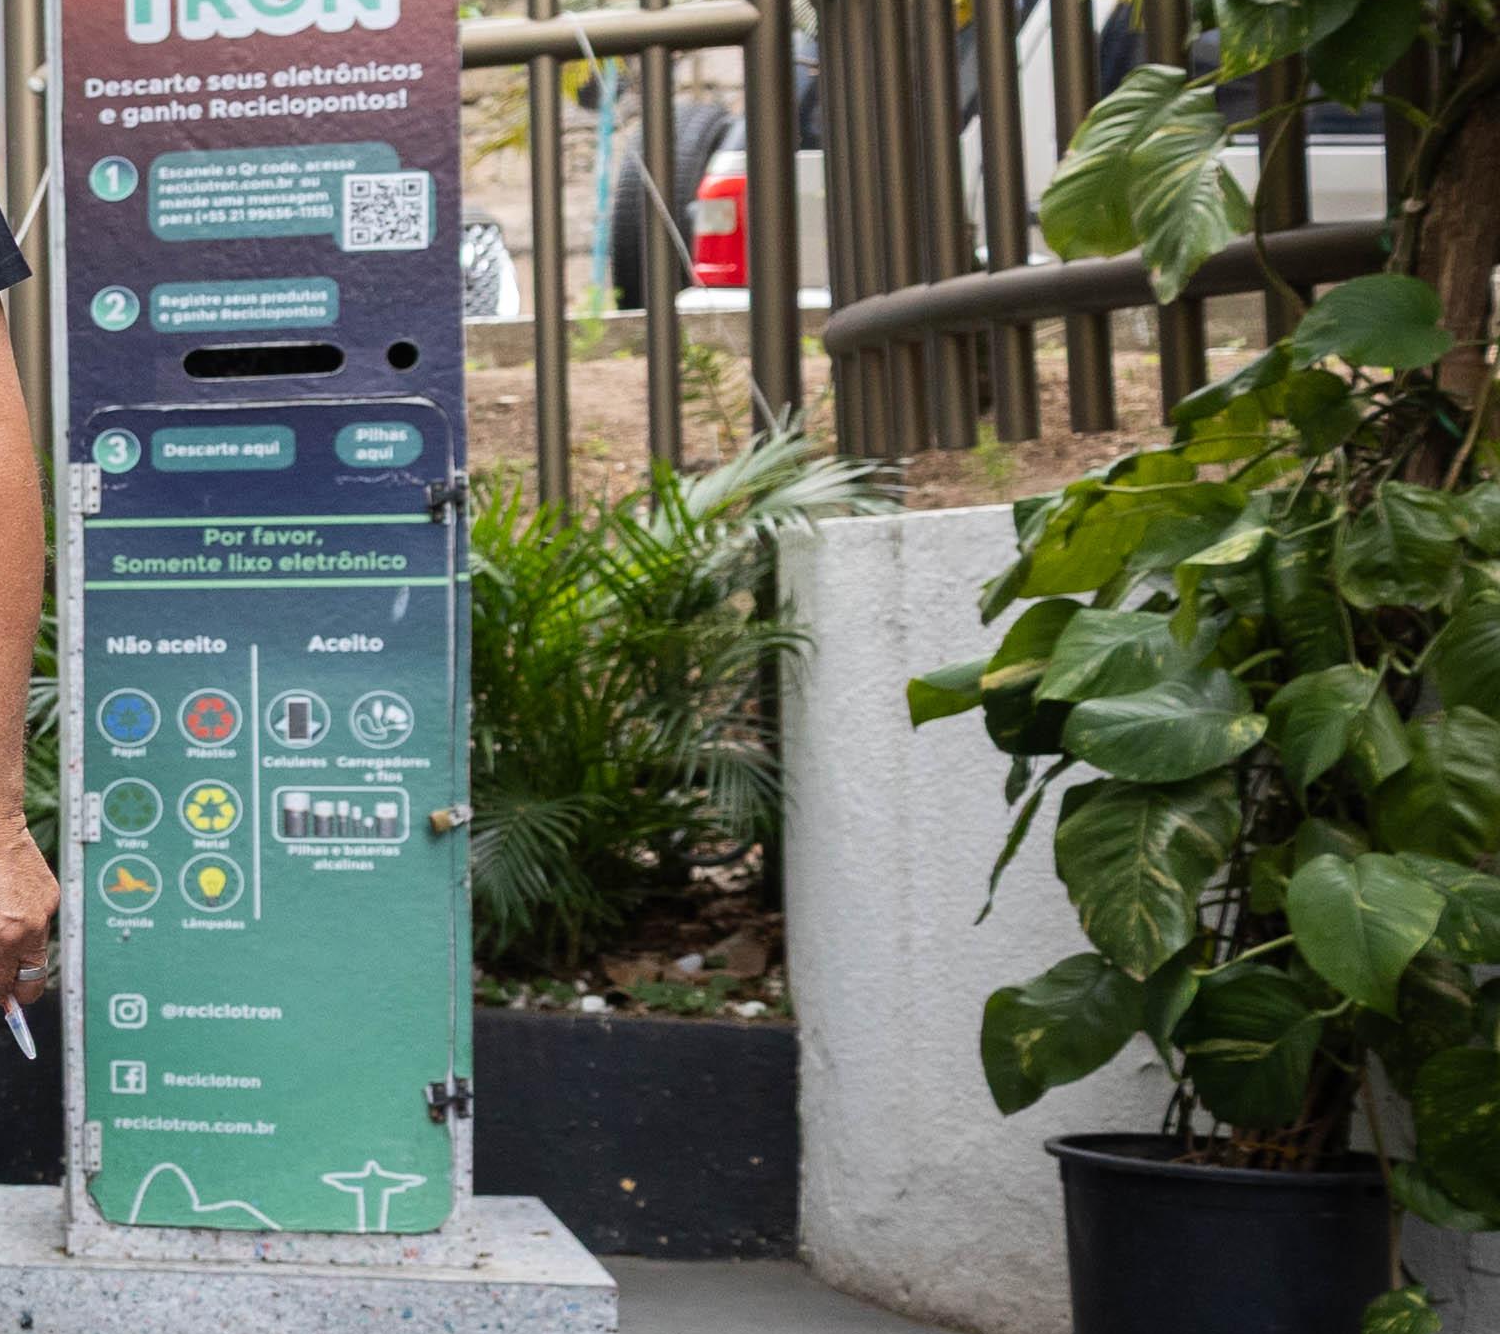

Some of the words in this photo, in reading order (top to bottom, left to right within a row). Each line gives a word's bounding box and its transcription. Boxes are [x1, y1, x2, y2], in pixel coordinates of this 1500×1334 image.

[84, 73, 201, 98] Descarte
[206, 71, 267, 92] seus
[272, 61, 423, 88] eletrônicos
[99, 107, 116, 124] e
[121, 100, 203, 128] ganhe
[209, 88, 408, 118] Reciclopontos!
[106, 166, 122, 193] 1
[105, 292, 127, 321] 2
[355, 427, 408, 443] Pilhas
[107, 435, 127, 464] 3
[164, 441, 239, 458] Descarte
[243, 441, 280, 458] aqui
[355, 447, 394, 462] aqui
[203, 528, 245, 546] Por
[112, 554, 222, 574] Somente
[228, 553, 272, 573] lixo
[279, 551, 407, 572] eletrônico
[106, 635, 152, 655] Não
[156, 635, 228, 655] aceito
[307, 634, 384, 653] Aceito
[161, 1003, 283, 1020] @reciclotron
[163, 1072, 262, 1089] Reciclotron
[114, 1117, 277, 1135] reciclotron.com.br
